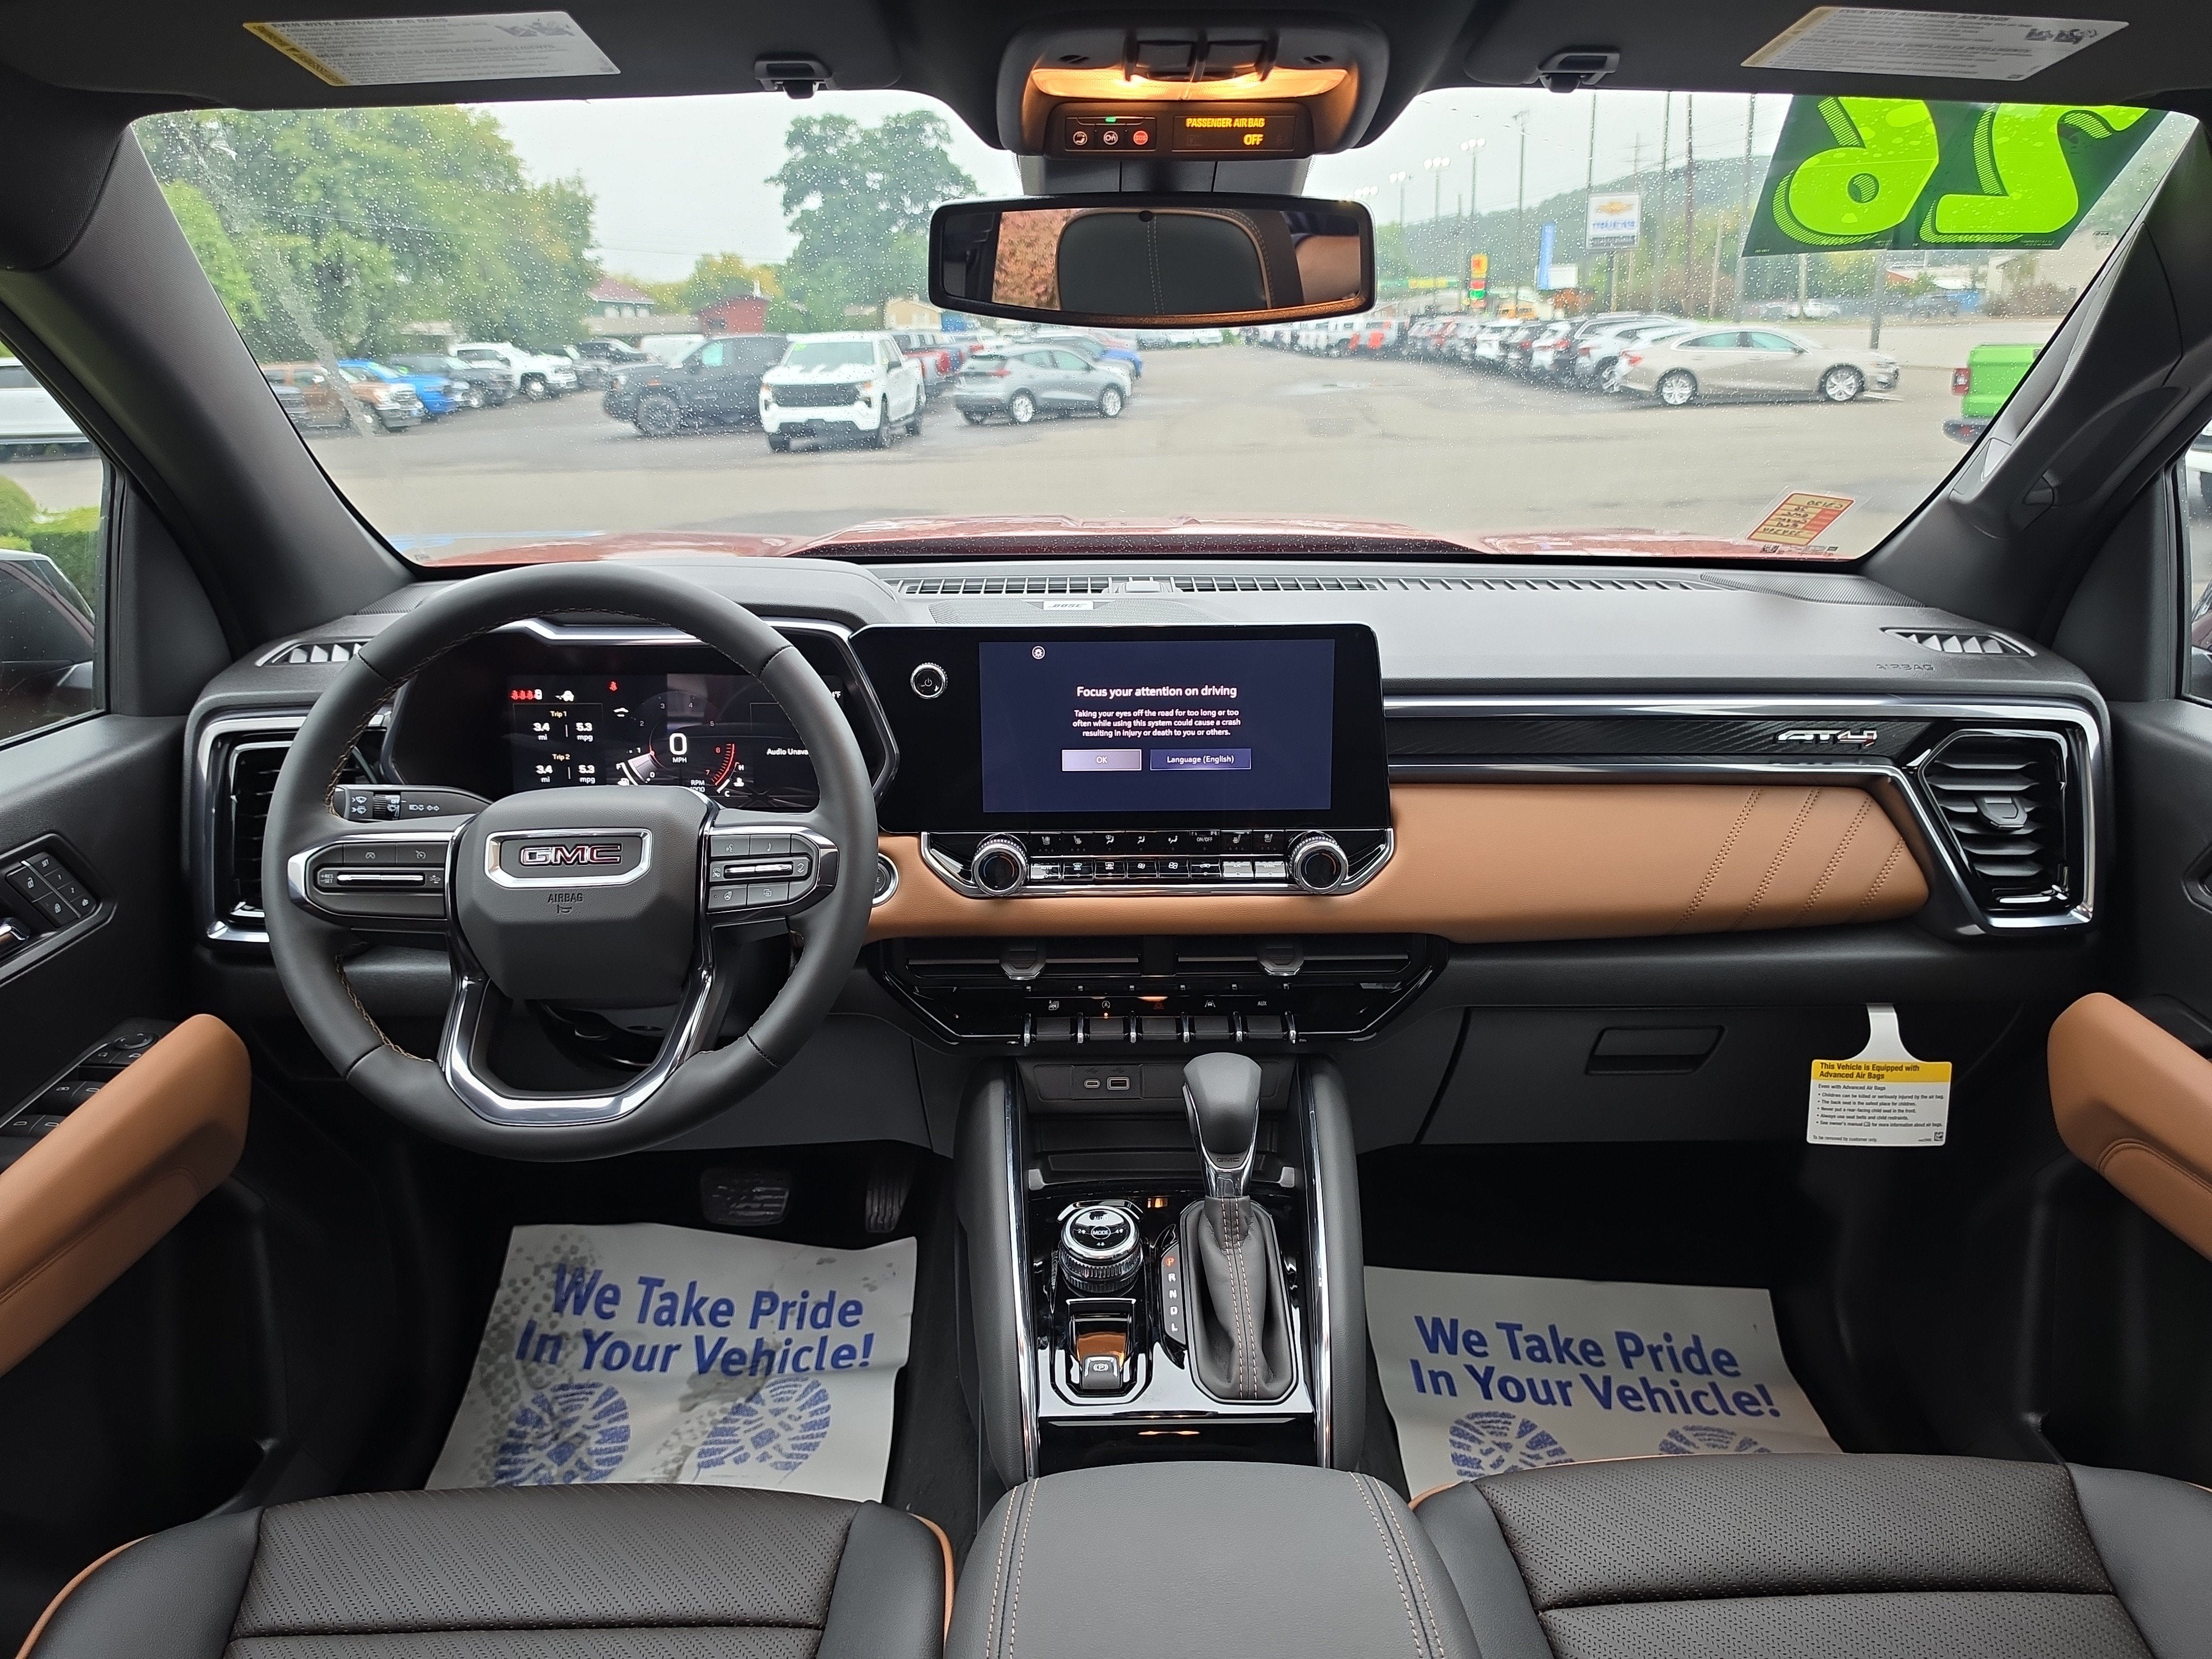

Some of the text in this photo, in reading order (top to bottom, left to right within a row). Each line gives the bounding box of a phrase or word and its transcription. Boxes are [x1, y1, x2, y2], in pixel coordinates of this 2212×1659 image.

[1186, 118, 1265, 128] PASSENGER AIR BAG
[1244, 134, 1264, 145] OFF
[1876, 664, 1935, 672] AIRBAG
[1077, 685, 1237, 699] Focus your attention on driving
[1074, 710, 1097, 718] Taking
[1098, 711, 1114, 719] your
[1200, 709, 1216, 718] long
[532, 722, 593, 732] 3.4 5.3
[1072, 719, 1091, 727] often
[1092, 719, 1111, 727] while
[1113, 719, 1131, 729] using
[1133, 719, 1146, 727] this
[1147, 720, 1172, 729] system
[1173, 718, 1192, 726] could
[1221, 718, 1241, 726] crash
[1083, 729, 1113, 739] resulting
[1122, 729, 1142, 739] injury
[1152, 728, 1173, 736] death
[1182, 730, 1195, 738] you
[1206, 728, 1231, 736] others.
[1776, 729, 1877, 747] AT4
[669, 732, 688, 755] 0
[1096, 756, 1108, 764] OK
[1167, 754, 1234, 766] Language (English)
[535, 765, 595, 774] 3.4 5.3
[520, 845, 621, 867] GMC
[548, 893, 583, 904] AIRBAG
[1167, 1258, 1174, 1266] P
[1168, 1272, 1175, 1282] R
[552, 1263, 864, 1330] We Take Pride
[1169, 1289, 1176, 1298] N
[1170, 1306, 1178, 1316] D
[1171, 1323, 1178, 1332] L
[516, 1320, 875, 1378] In Your Vehicle!
[1413, 1315, 1742, 1378] We Take Pride
[1410, 1359, 1781, 1418] In Your Vehicle!
